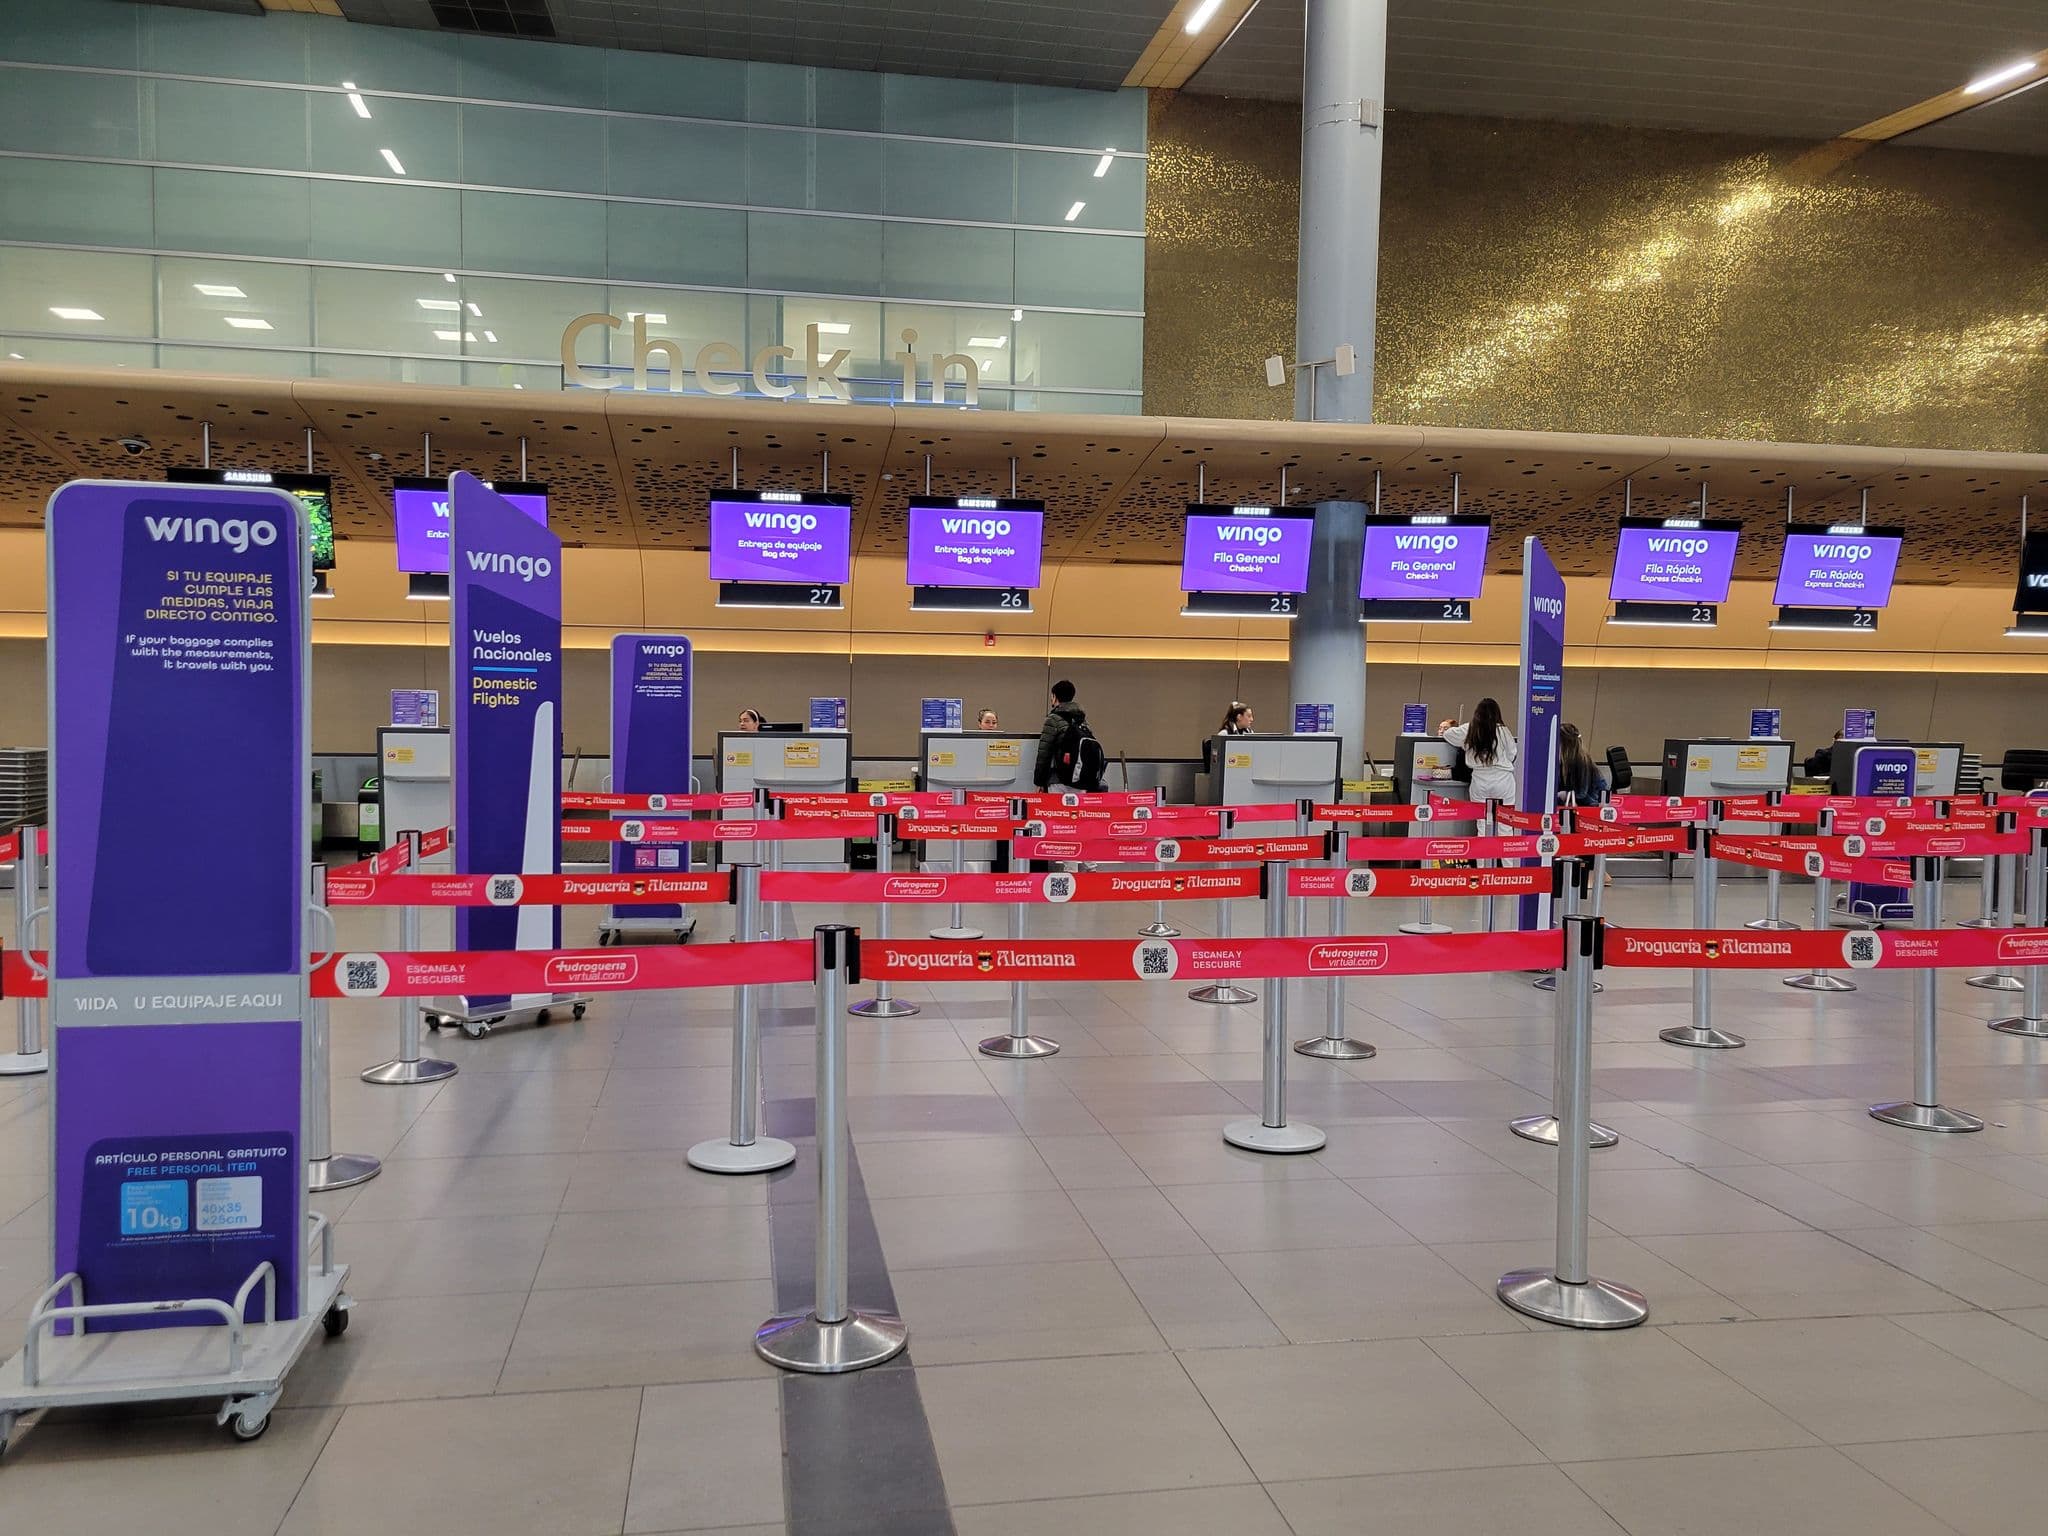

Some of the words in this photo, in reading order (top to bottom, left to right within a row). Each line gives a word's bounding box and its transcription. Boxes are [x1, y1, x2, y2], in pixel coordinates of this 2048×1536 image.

[561, 312, 852, 403] Check
[896, 328, 979, 404] in
[744, 512, 817, 534] wingo
[941, 518, 1011, 539] wingo
[144, 516, 277, 553] wingo
[1217, 526, 1282, 546] wingo
[738, 540, 772, 549] Entrega
[774, 541, 785, 549] de
[787, 542, 822, 551] equipaje
[935, 545, 968, 554] Entrega
[969, 546, 980, 554] de
[981, 547, 1015, 556] equipaje
[1395, 535, 1458, 554] wingo
[1648, 538, 1708, 557] wingo
[779, 551, 798, 559] drop
[973, 556, 992, 564] drop
[1213, 552, 1233, 563] Fila
[1236, 553, 1280, 564] General
[1813, 544, 1871, 563] wingo
[466, 551, 551, 582] wingo
[1229, 565, 1263, 573] Check-in
[1391, 561, 1410, 571] Fila
[1412, 561, 1456, 571] General
[1645, 564, 1663, 574] Fila
[1666, 564, 1701, 576] Rápida
[167, 571, 179, 581] SI
[183, 571, 201, 581] TU
[205, 572, 272, 584] EQUIPAJE
[1405, 572, 1438, 580] Check-in
[1641, 574, 1669, 583] Express
[1671, 575, 1703, 583] Check-in
[1809, 570, 1827, 579] Fila
[1829, 570, 1863, 581] Rápida
[184, 584, 243, 596] CUMPLE
[248, 586, 273, 597] LAS
[1804, 580, 1833, 589] Express
[1834, 581, 1864, 589] Check-in
[161, 597, 229, 609] MEDIDAS,
[233, 599, 273, 609] VIAJA
[810, 589, 832, 604] 27
[1001, 593, 1021, 607] 26
[1270, 598, 1290, 612] 25
[1443, 605, 1463, 618] 24
[1534, 596, 1562, 619] wingo
[145, 609, 206, 620] DIRECTO
[211, 610, 278, 622] CONTIGO.
[1692, 608, 1711, 621] 23
[1853, 614, 1872, 627] 22
[126, 634, 136, 643] If
[139, 636, 166, 646] your
[170, 635, 220, 647] baggage
[223, 637, 274, 648] complies
[473, 630, 521, 645] Vuelos
[132, 648, 158, 657] with
[162, 648, 182, 657] the
[185, 650, 274, 660] measurements,
[473, 646, 552, 663] Nacionales
[642, 645, 684, 658] wingo
[164, 660, 173, 669] it
[177, 661, 218, 670] travels
[221, 662, 246, 671] with
[249, 663, 274, 673] you.
[473, 677, 538, 691] Domestic
[473, 691, 520, 709] Flights
[1875, 764, 1907, 774] wingo
[908, 823, 949, 834] Droguería
[960, 823, 998, 833] Alemana
[1584, 837, 1625, 848] Droguería
[1636, 834, 1674, 844] Alemana
[1208, 844, 1254, 855] Droguería
[1266, 842, 1308, 852] Alemana
[563, 880, 630, 895] Droguería
[648, 879, 707, 892] Alemana
[1112, 877, 1171, 891] Droguería
[1187, 876, 1241, 887] Alemana
[1410, 874, 1466, 888] Droguería
[1482, 874, 1533, 885] Alemana
[1625, 937, 1701, 956] Droguería
[1722, 938, 1791, 954] Alemana
[1894, 940, 1932, 948] ESCANEA
[1192, 951, 1235, 959] ESCANEA
[1896, 949, 1938, 957] DESCUBRE
[885, 950, 974, 970] Droguería
[997, 950, 1075, 967] Alemana
[1193, 960, 1241, 969] DESCUBRE
[1329, 958, 1377, 967] virtual.com
[407, 965, 456, 974] ESCANEA
[459, 964, 465, 973] Y
[408, 975, 465, 984] DESCUBRE
[569, 972, 625, 982] virtual.com
[152, 995, 237, 1009] EQUIPAJE
[240, 994, 282, 1007] AQUI
[95, 1152, 158, 1165] ARTÍCULO
[161, 1150, 224, 1162] PERSONAL
[227, 1147, 287, 1159] GRATUITO
[127, 1167, 157, 1176] FREE
[162, 1164, 224, 1175] PERSONAL
[228, 1162, 257, 1172] ITEM
[127, 1207, 182, 1230] 10kg
